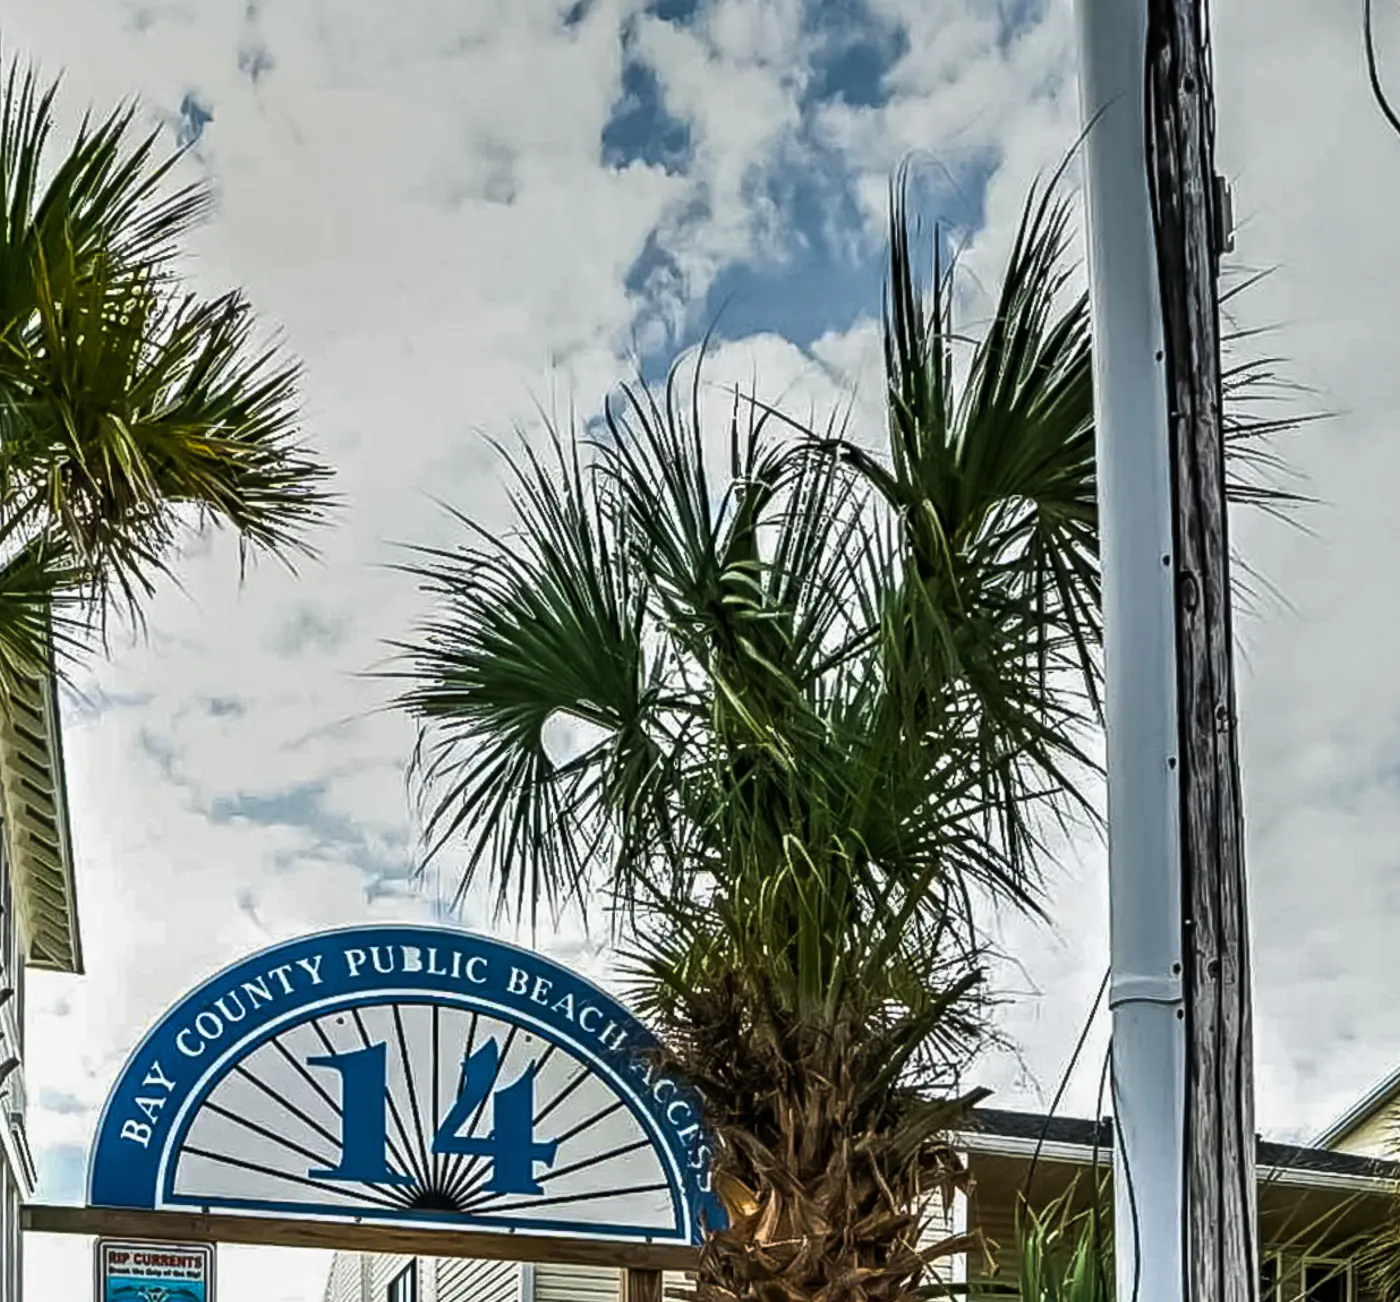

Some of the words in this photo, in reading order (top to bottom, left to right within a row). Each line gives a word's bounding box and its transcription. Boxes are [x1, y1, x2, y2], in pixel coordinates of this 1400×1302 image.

[120, 1060, 176, 1149] BAY
[175, 955, 324, 1057] COUNTY
[344, 945, 488, 984] PUBLIC
[506, 966, 629, 1052] BEACH
[306, 1036, 560, 1195] 14
[108, 1251, 130, 1264] RIP
[133, 1252, 203, 1269] CURRENTS
